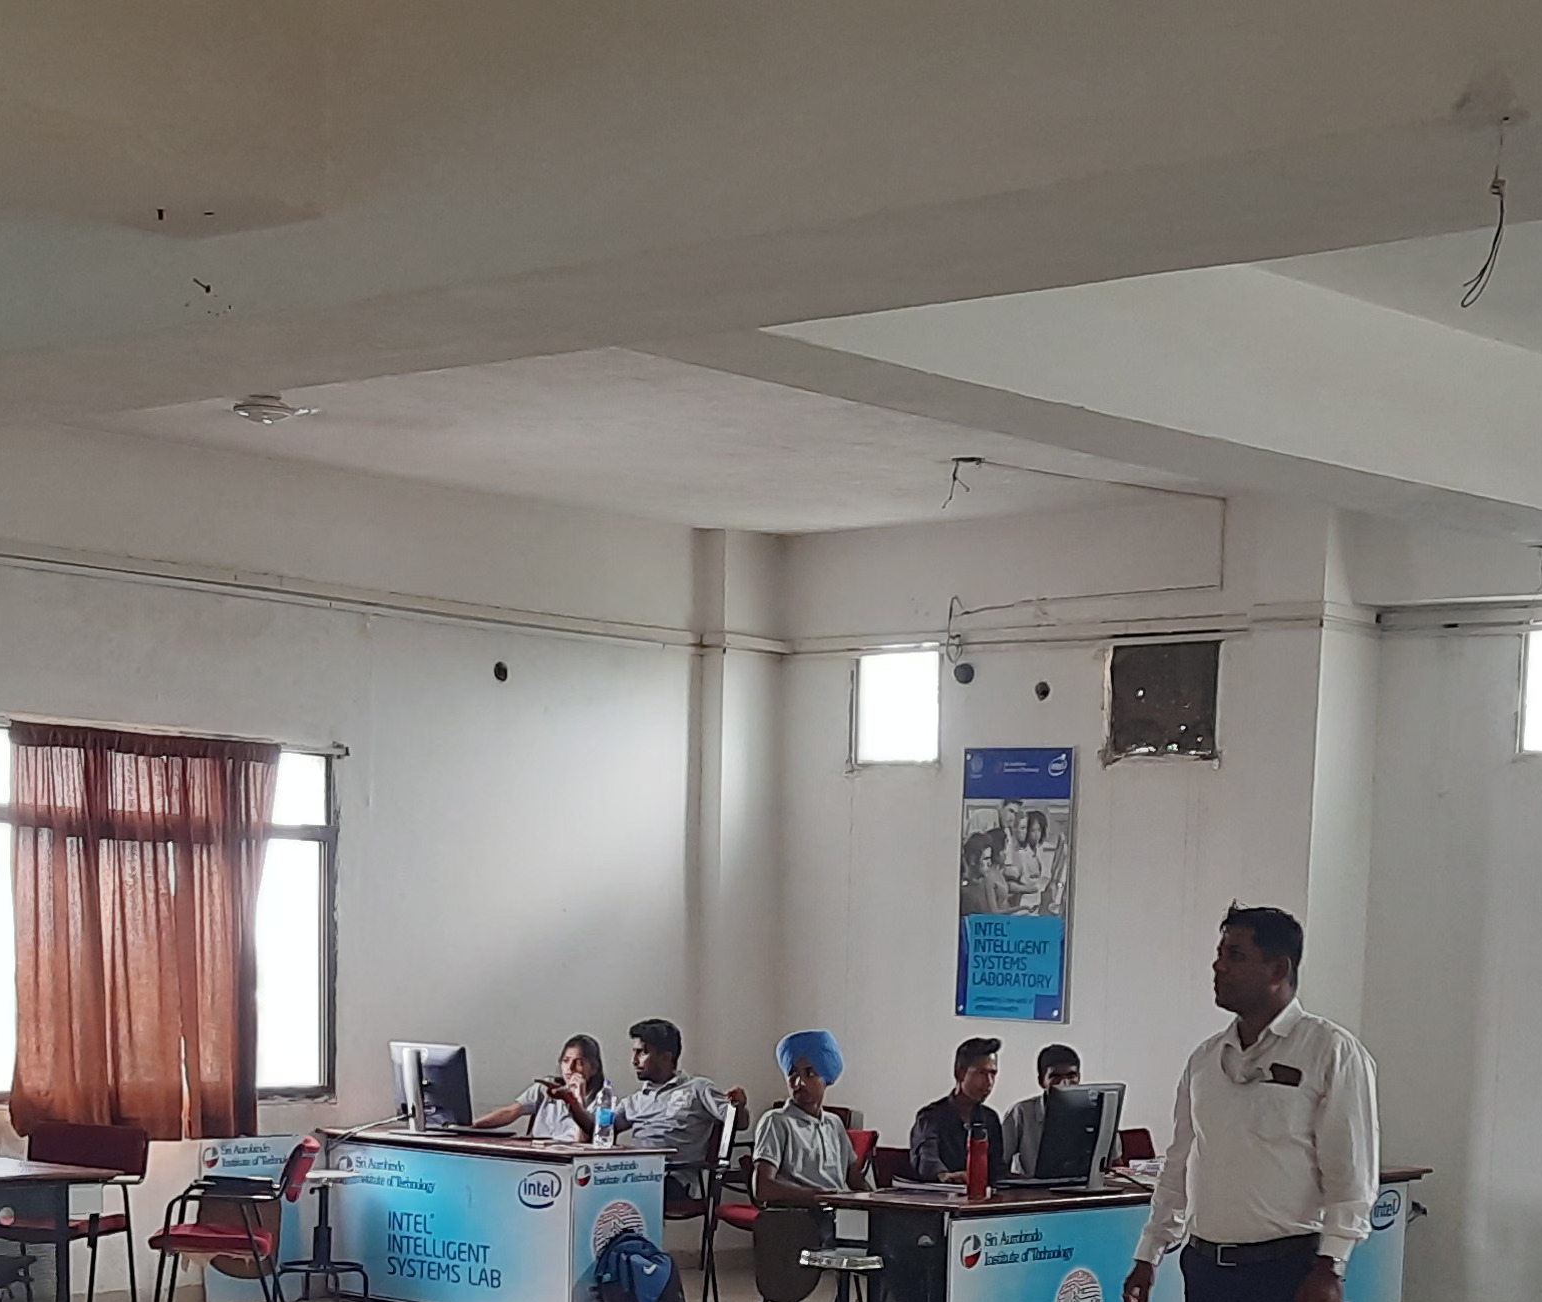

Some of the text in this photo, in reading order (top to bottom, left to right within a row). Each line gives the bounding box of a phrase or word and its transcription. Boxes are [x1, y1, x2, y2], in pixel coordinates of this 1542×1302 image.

[974, 922, 1008, 937] INTEL
[973, 938, 1049, 954] INTELLIGENT
[973, 955, 1027, 971] SYSTEMS
[972, 971, 1052, 989] LABORATORY
[523, 1177, 555, 1198] intel
[1373, 1198, 1398, 1219] intel
[387, 1210, 432, 1235] INTEL
[387, 1233, 491, 1264] INTELLIGENT
[387, 1256, 502, 1288] SYSTEMS LAB
